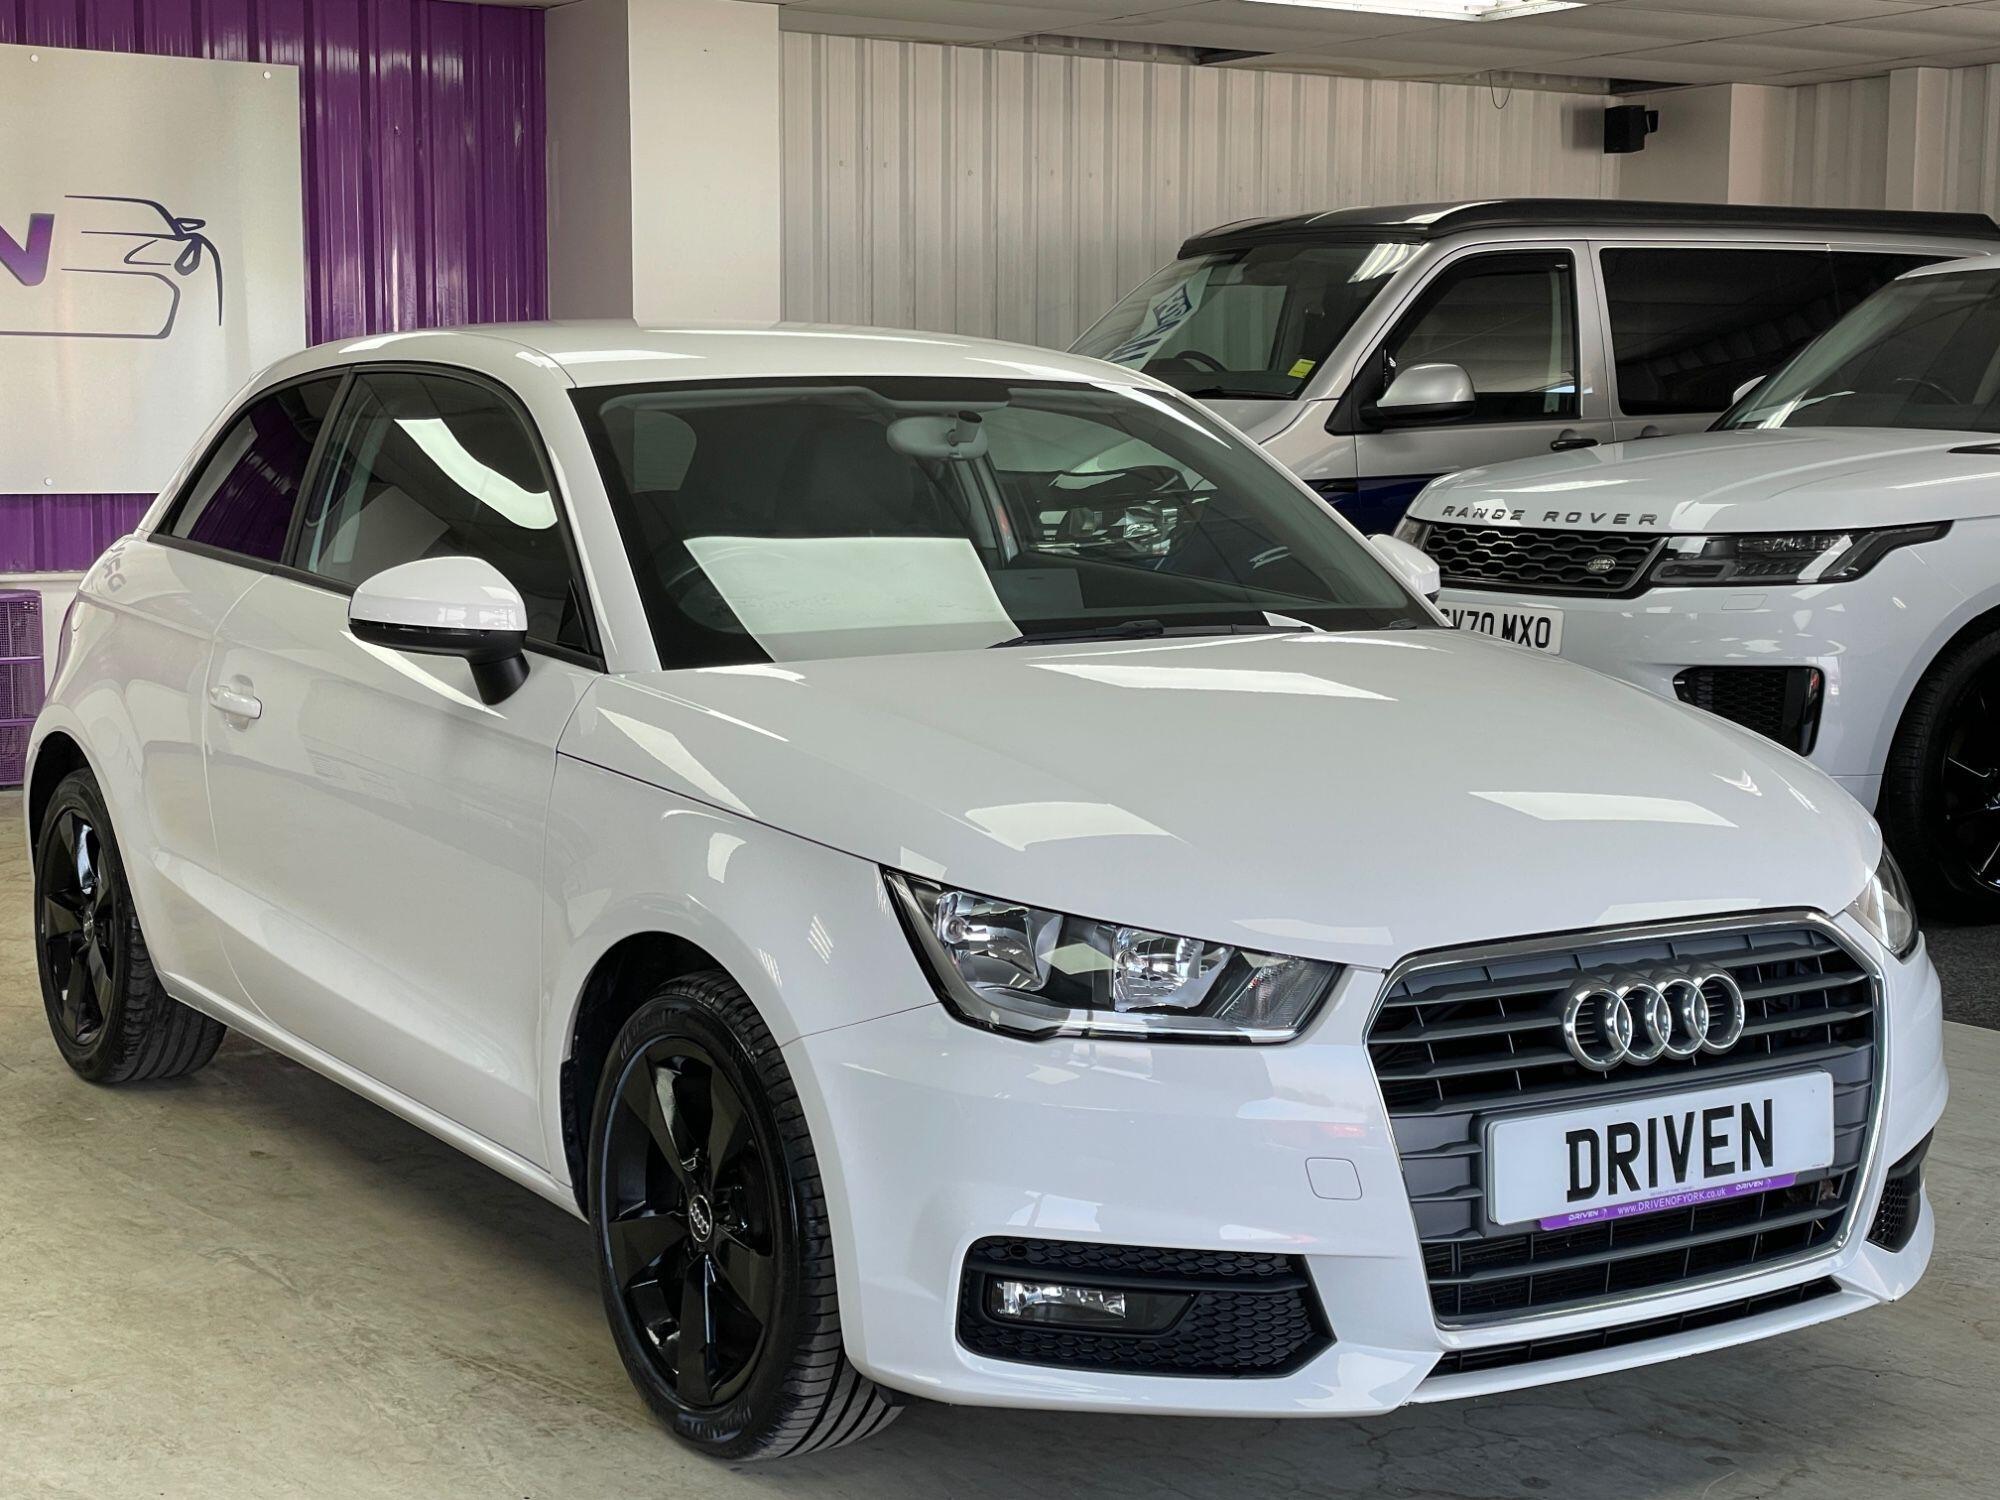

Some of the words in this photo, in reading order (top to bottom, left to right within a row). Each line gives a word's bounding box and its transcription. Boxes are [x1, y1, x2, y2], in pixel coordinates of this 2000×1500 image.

[1441, 505, 1526, 521] RANGE
[1542, 511, 1658, 526] ROVER
[1501, 613, 1552, 649] MXO
[1565, 1098, 1774, 1203] DRIVEN
[1568, 1209, 1600, 1221] DRIVEN
[1617, 1187, 1727, 1216] www.DRIVENOFYORK.co.uk
[1735, 1179, 1764, 1192] DRIVEN
